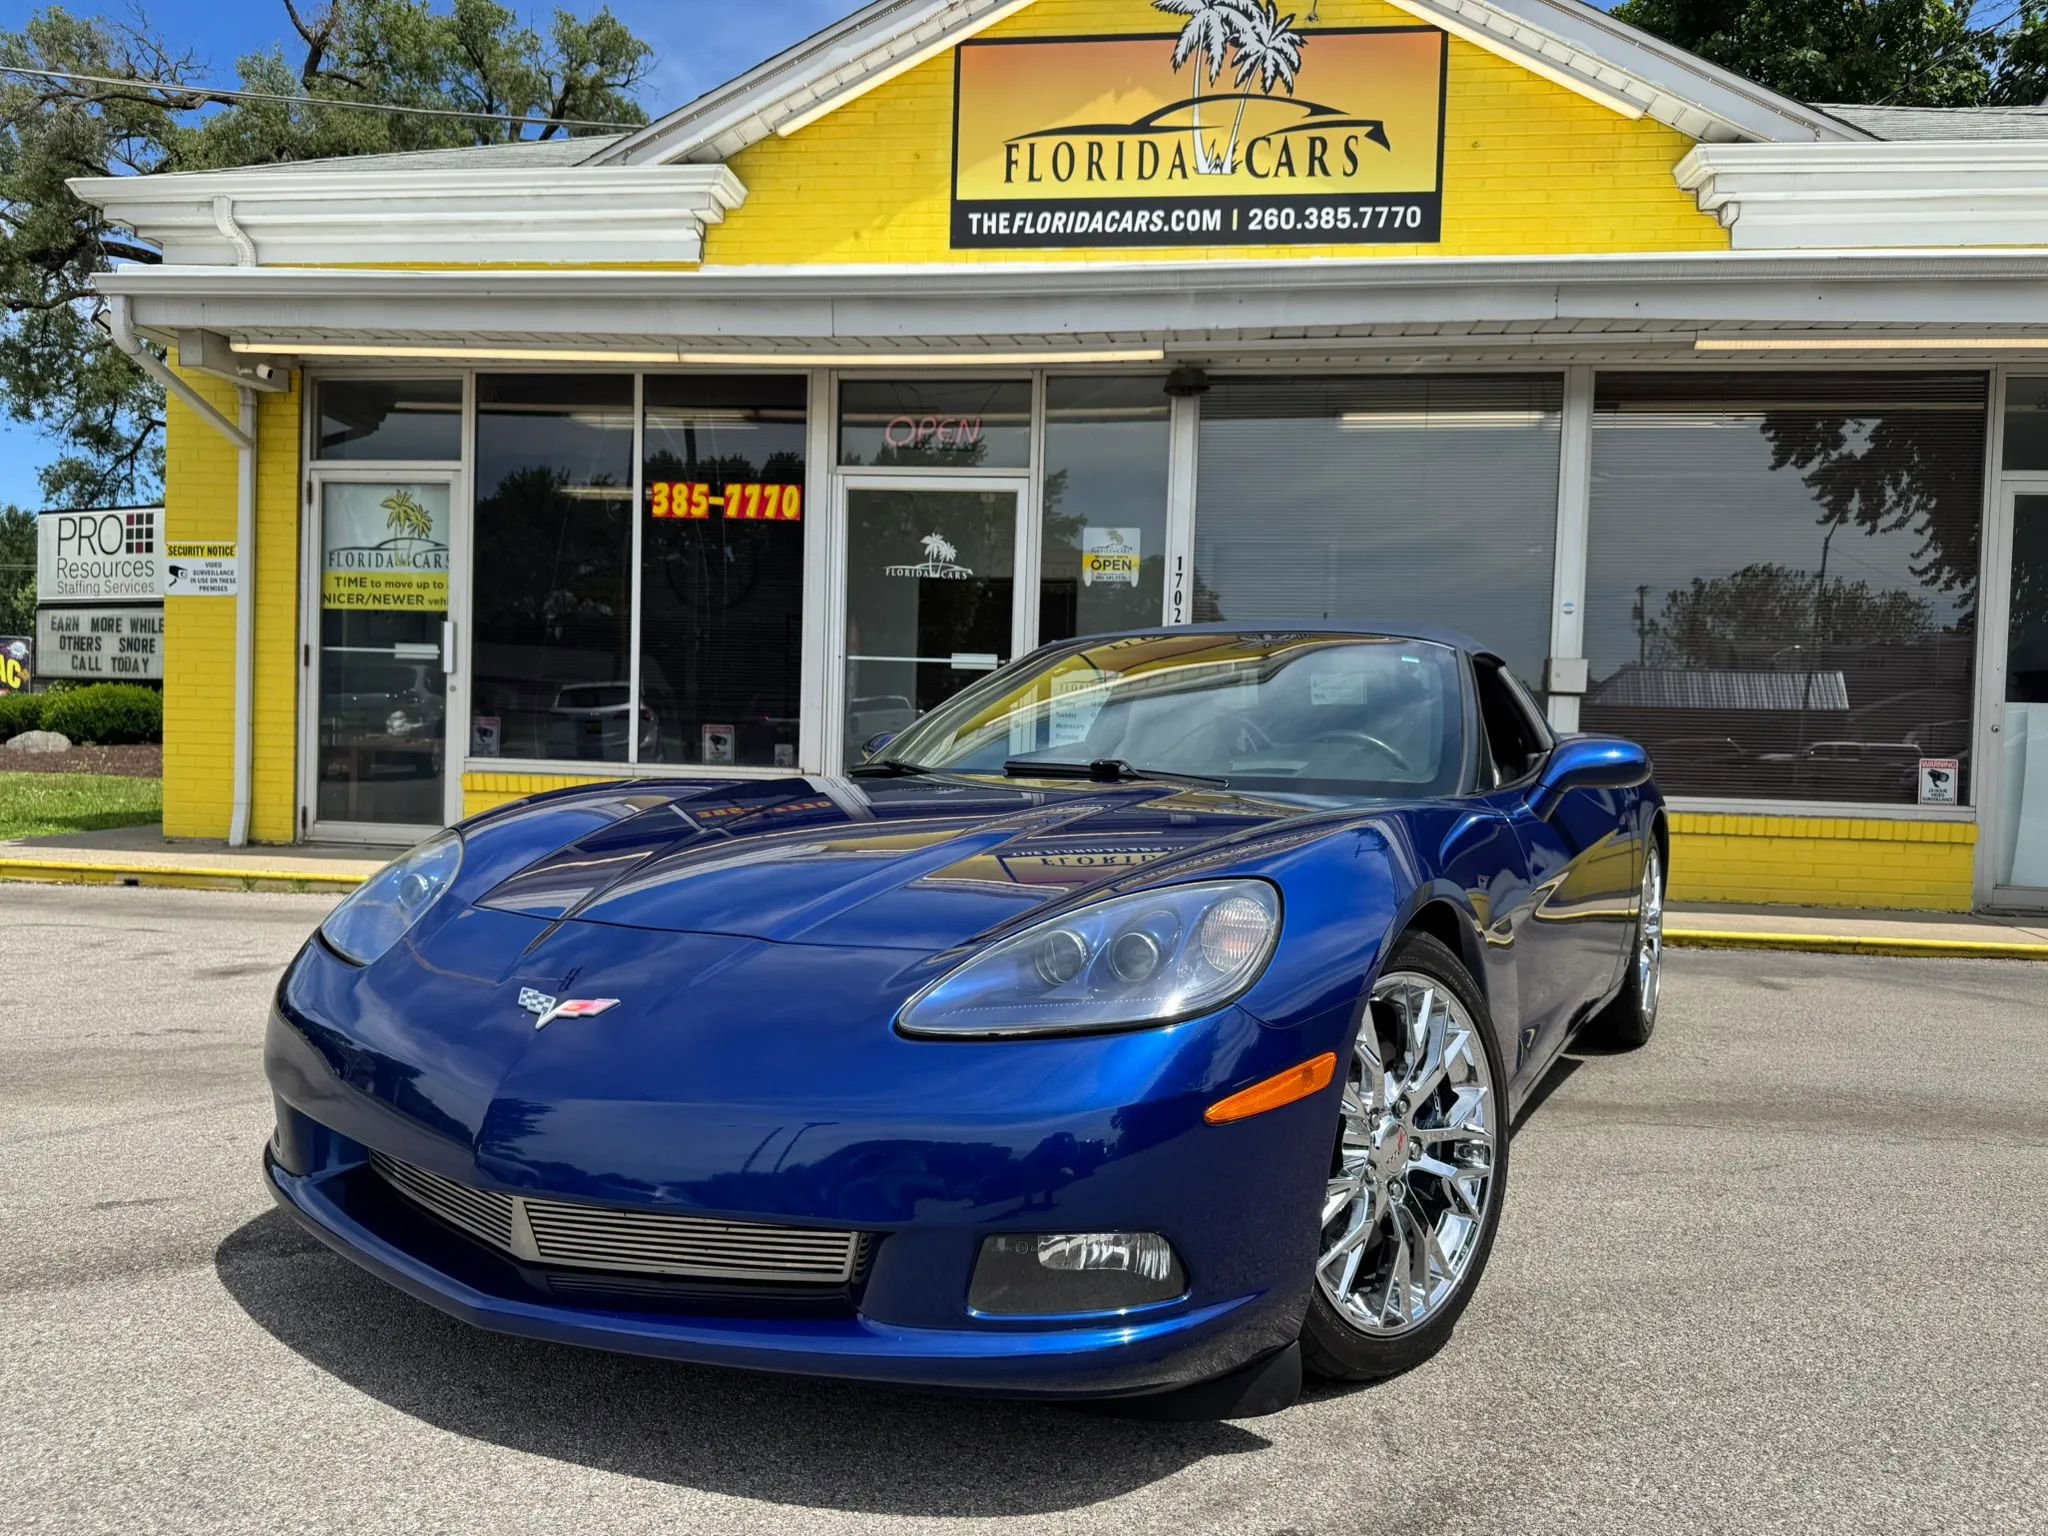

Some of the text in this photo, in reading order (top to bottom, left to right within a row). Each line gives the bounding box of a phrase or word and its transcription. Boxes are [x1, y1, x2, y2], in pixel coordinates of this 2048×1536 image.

[1003, 134, 1360, 184] FLORIDA CARS
[967, 208, 1222, 235] THEFLORIDACARS.COM
[1247, 205, 1422, 231] 260.385.7770
[884, 415, 982, 449] OPEN
[651, 481, 800, 518] 385-7770
[57, 514, 124, 556] PRO
[167, 545, 235, 557] SECURITY NOTICE
[328, 551, 394, 569] FLORIDA
[57, 558, 155, 580] Resources
[192, 569, 234, 577] SURVEILLANCE
[205, 561, 223, 569] VIDEO
[885, 567, 969, 581] FLORIDA CARS
[1091, 559, 1132, 571] OPEN
[57, 579, 155, 596] Staffing Services
[219, 577, 236, 585] THESE
[334, 576, 368, 588] TIME
[371, 579, 381, 588] to
[416, 582, 430, 590] up
[433, 580, 444, 590] to
[1173, 555, 1183, 624] 1702
[322, 592, 425, 606] NICER/NEWER
[50, 615, 164, 635] EARN MORE WHILE
[59, 635, 156, 654] OTHERS SNORE
[71, 654, 150, 673] CALL TODAY
[1921, 761, 1956, 769] WARNING
